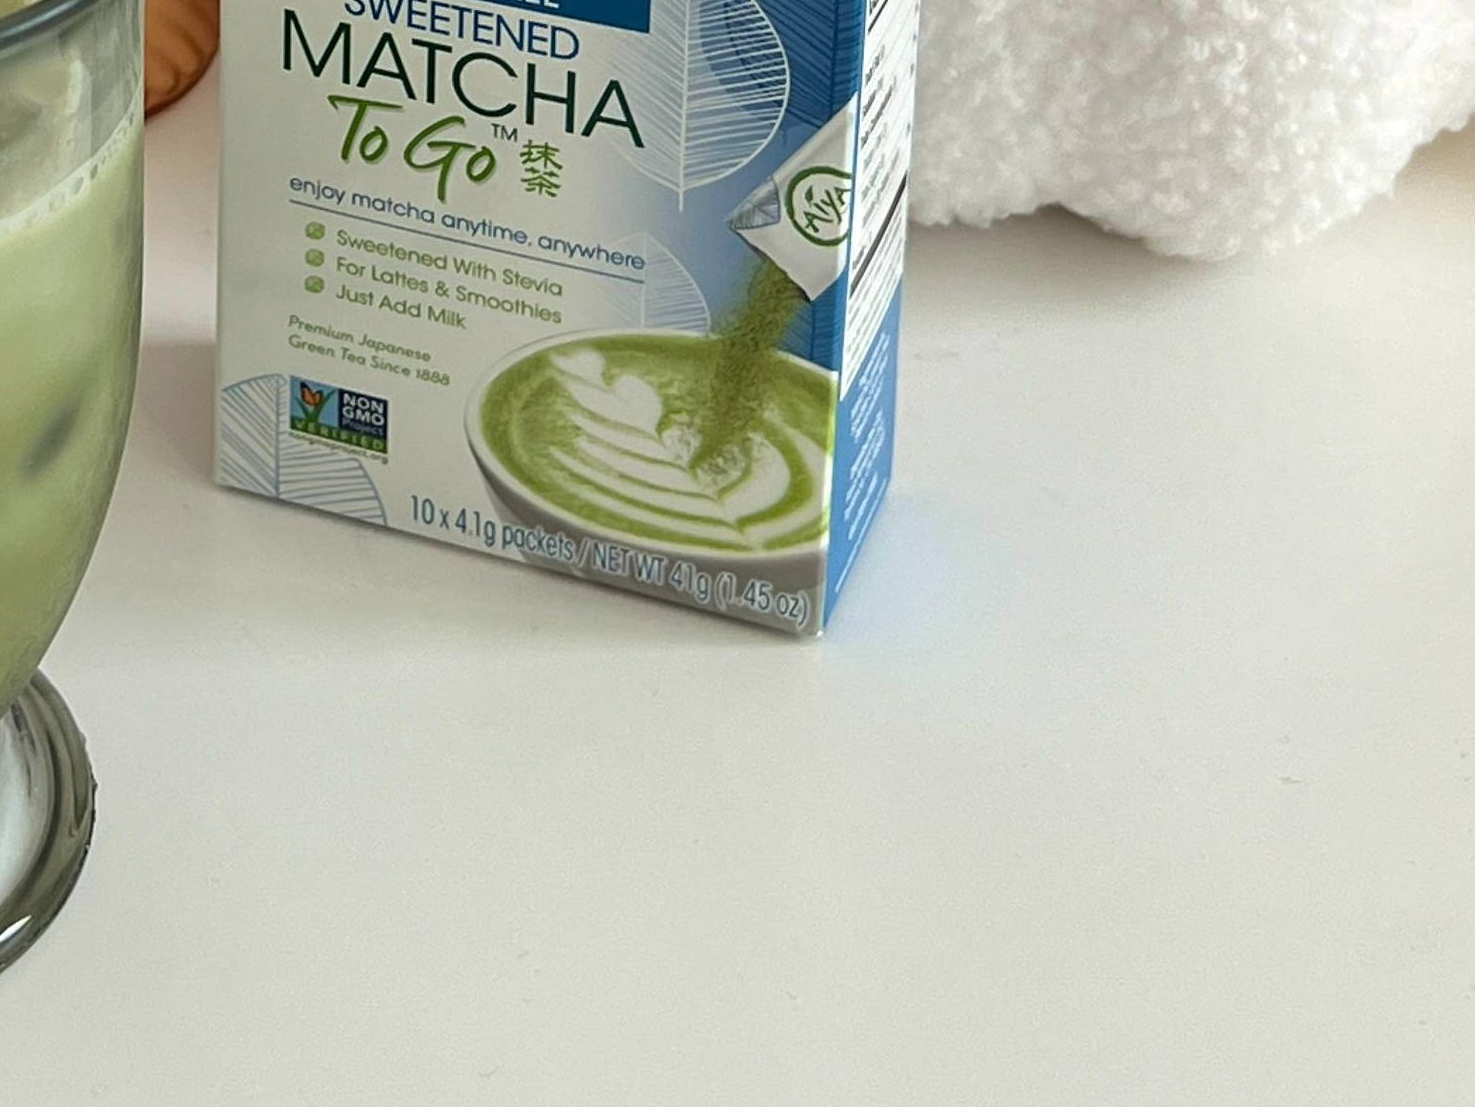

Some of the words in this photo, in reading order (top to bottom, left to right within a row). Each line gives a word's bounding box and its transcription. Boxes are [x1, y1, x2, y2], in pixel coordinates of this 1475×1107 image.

[283, 8, 645, 149] MATCHA
[327, 95, 404, 164] To
[403, 115, 497, 205] Go
[289, 175, 346, 205] enjoy
[351, 189, 435, 224] matcha
[538, 232, 646, 271] anywhere
[336, 229, 448, 271] Sweetened
[453, 257, 497, 282] With
[502, 268, 564, 297] Stevia
[336, 256, 367, 277] For
[371, 263, 429, 294] Lattes
[435, 281, 450, 299] &
[455, 285, 563, 325] Smoothies
[289, 315, 354, 343] Premium
[359, 334, 432, 363] Japanese
[335, 284, 374, 307] Just
[379, 295, 422, 318] Add
[428, 304, 467, 329] Milk
[288, 334, 335, 358] Green
[340, 347, 366, 366] Tea
[370, 354, 411, 377] Since
[416, 368, 451, 387] 1888
[342, 406, 384, 426] GMO
[343, 392, 384, 414] NON
[411, 494, 435, 525] 10
[439, 510, 450, 530] x
[455, 507, 497, 547] 4.1g
[502, 521, 575, 563] packets
[593, 541, 632, 575] NET
[633, 553, 669, 585] WT
[671, 560, 711, 601] 41g
[714, 570, 772, 613] (1.45
[776, 591, 811, 627] oz)
